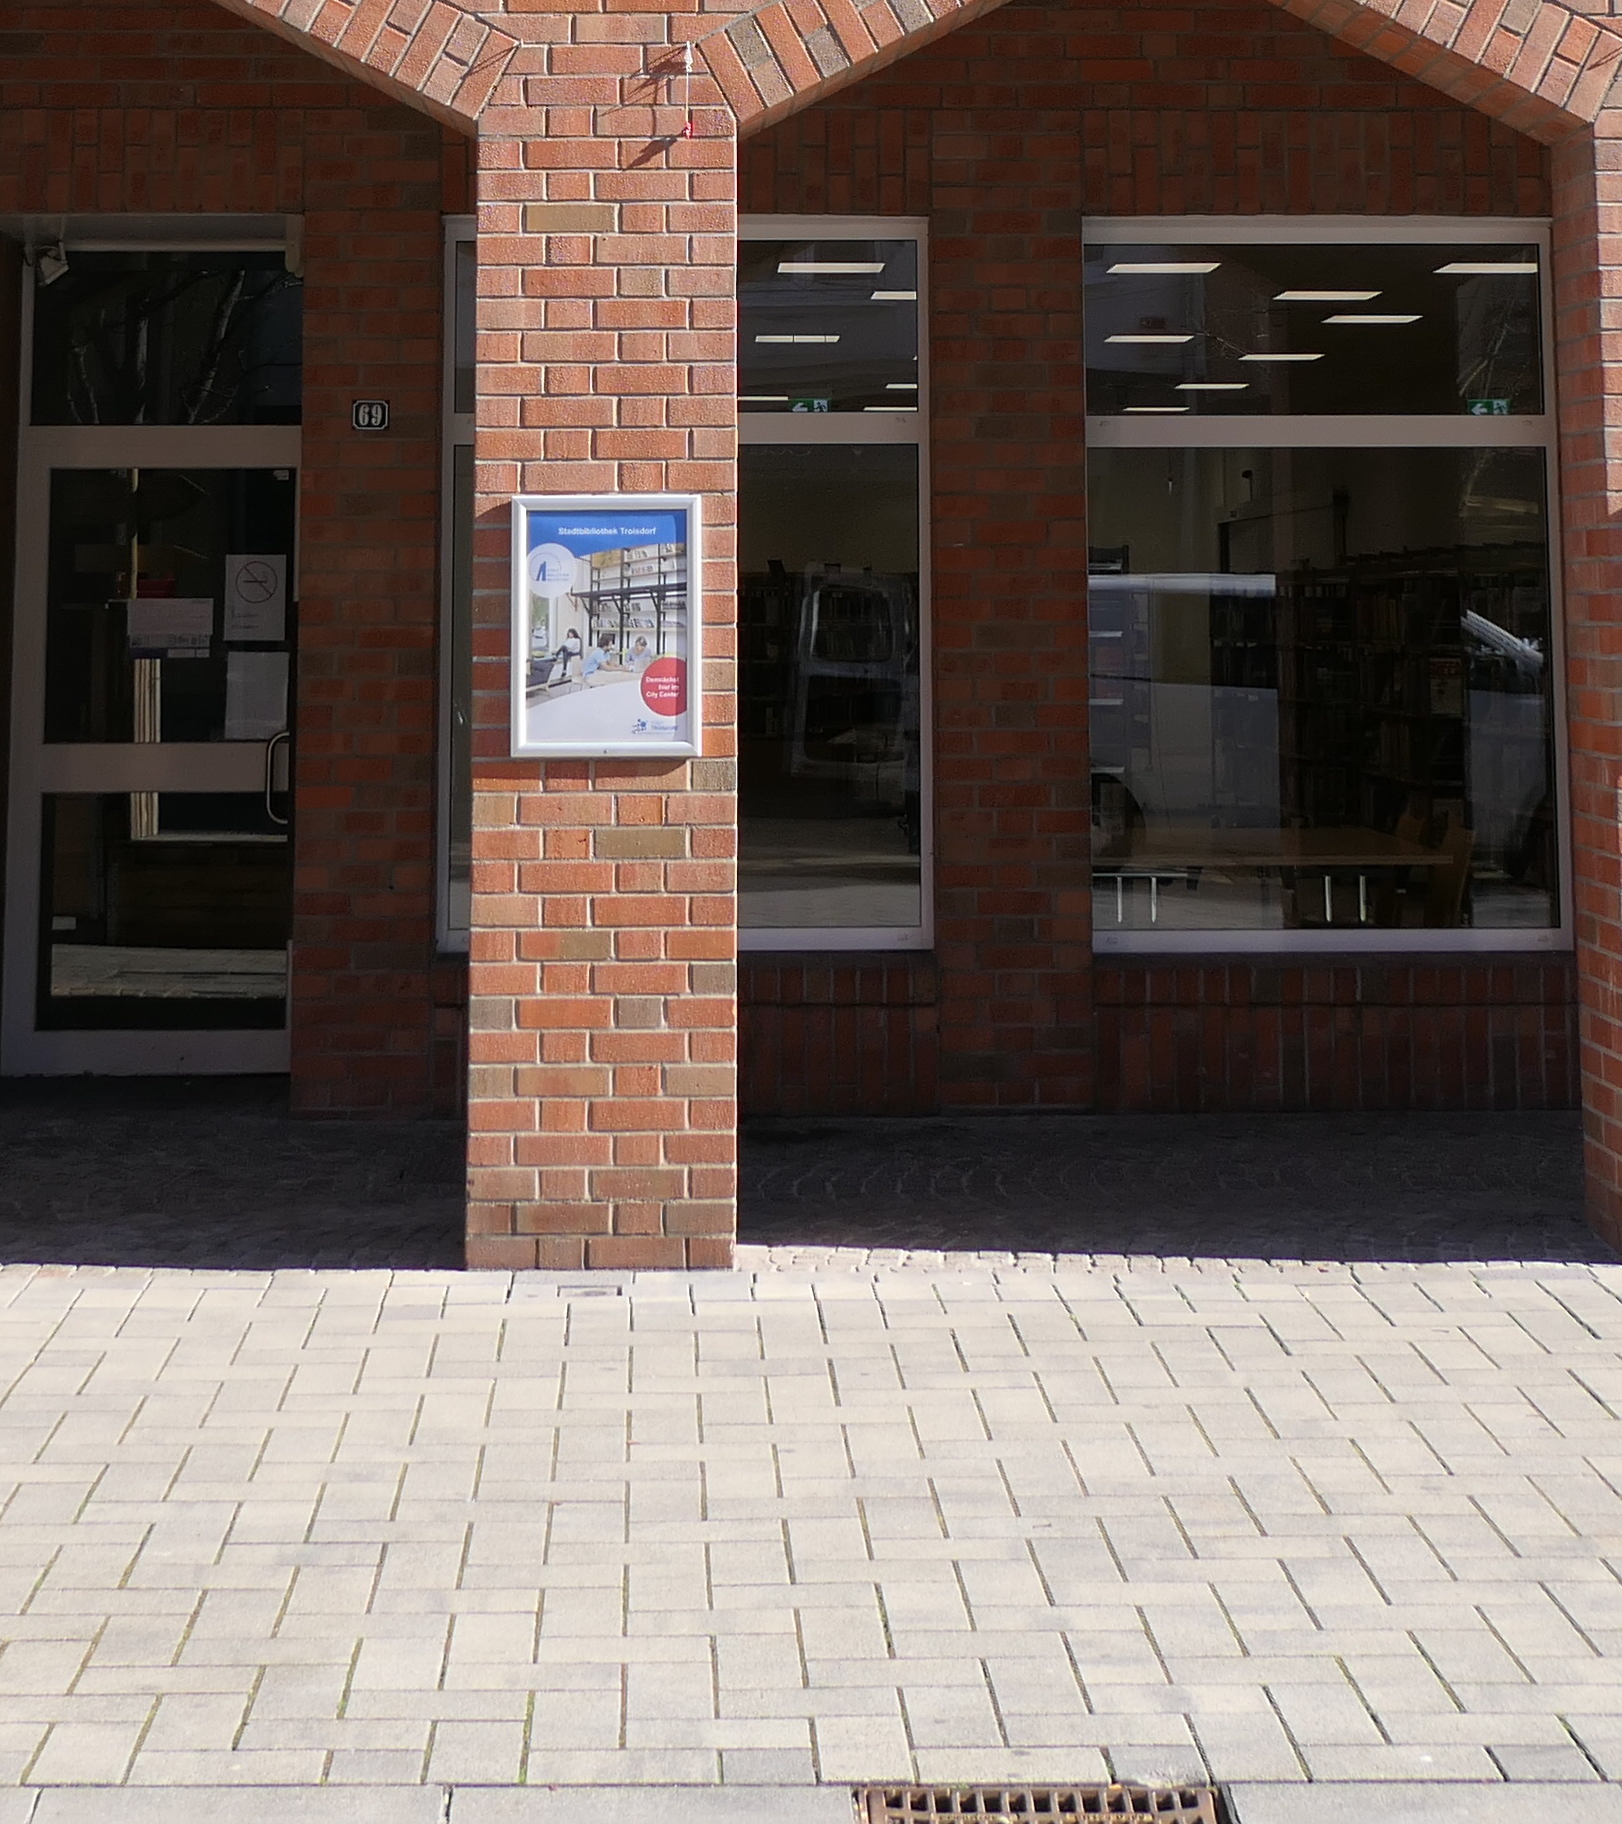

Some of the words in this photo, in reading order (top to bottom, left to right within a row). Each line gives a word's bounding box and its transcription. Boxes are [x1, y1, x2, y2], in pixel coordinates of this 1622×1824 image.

[359, 404, 383, 426] 69
[558, 527, 618, 535] Stadtbibliothek
[620, 527, 657, 535] Troisdorf
